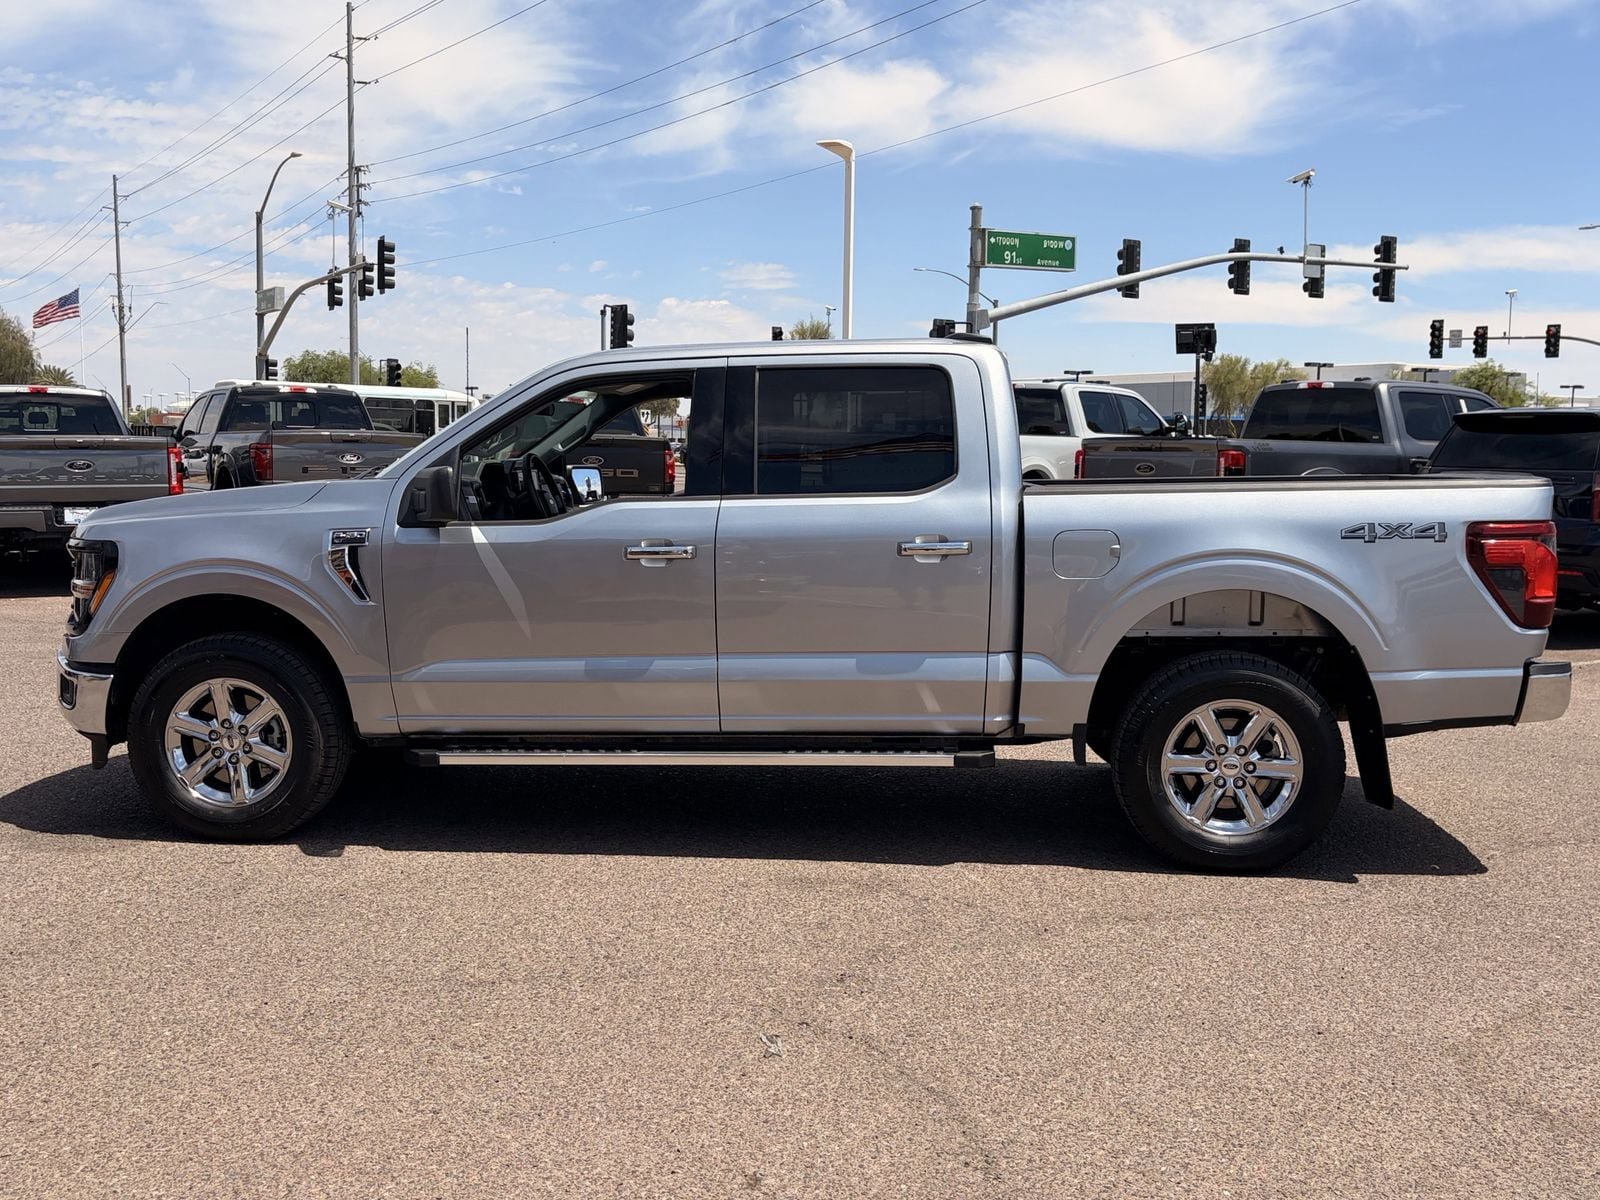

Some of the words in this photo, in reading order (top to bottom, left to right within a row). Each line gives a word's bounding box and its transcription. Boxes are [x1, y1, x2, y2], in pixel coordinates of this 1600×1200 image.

[1003, 250, 1023, 265] 91st
[1036, 258, 1060, 267] Avenue
[342, 454, 359, 463] Ford
[1341, 522, 1447, 543] 4X4
